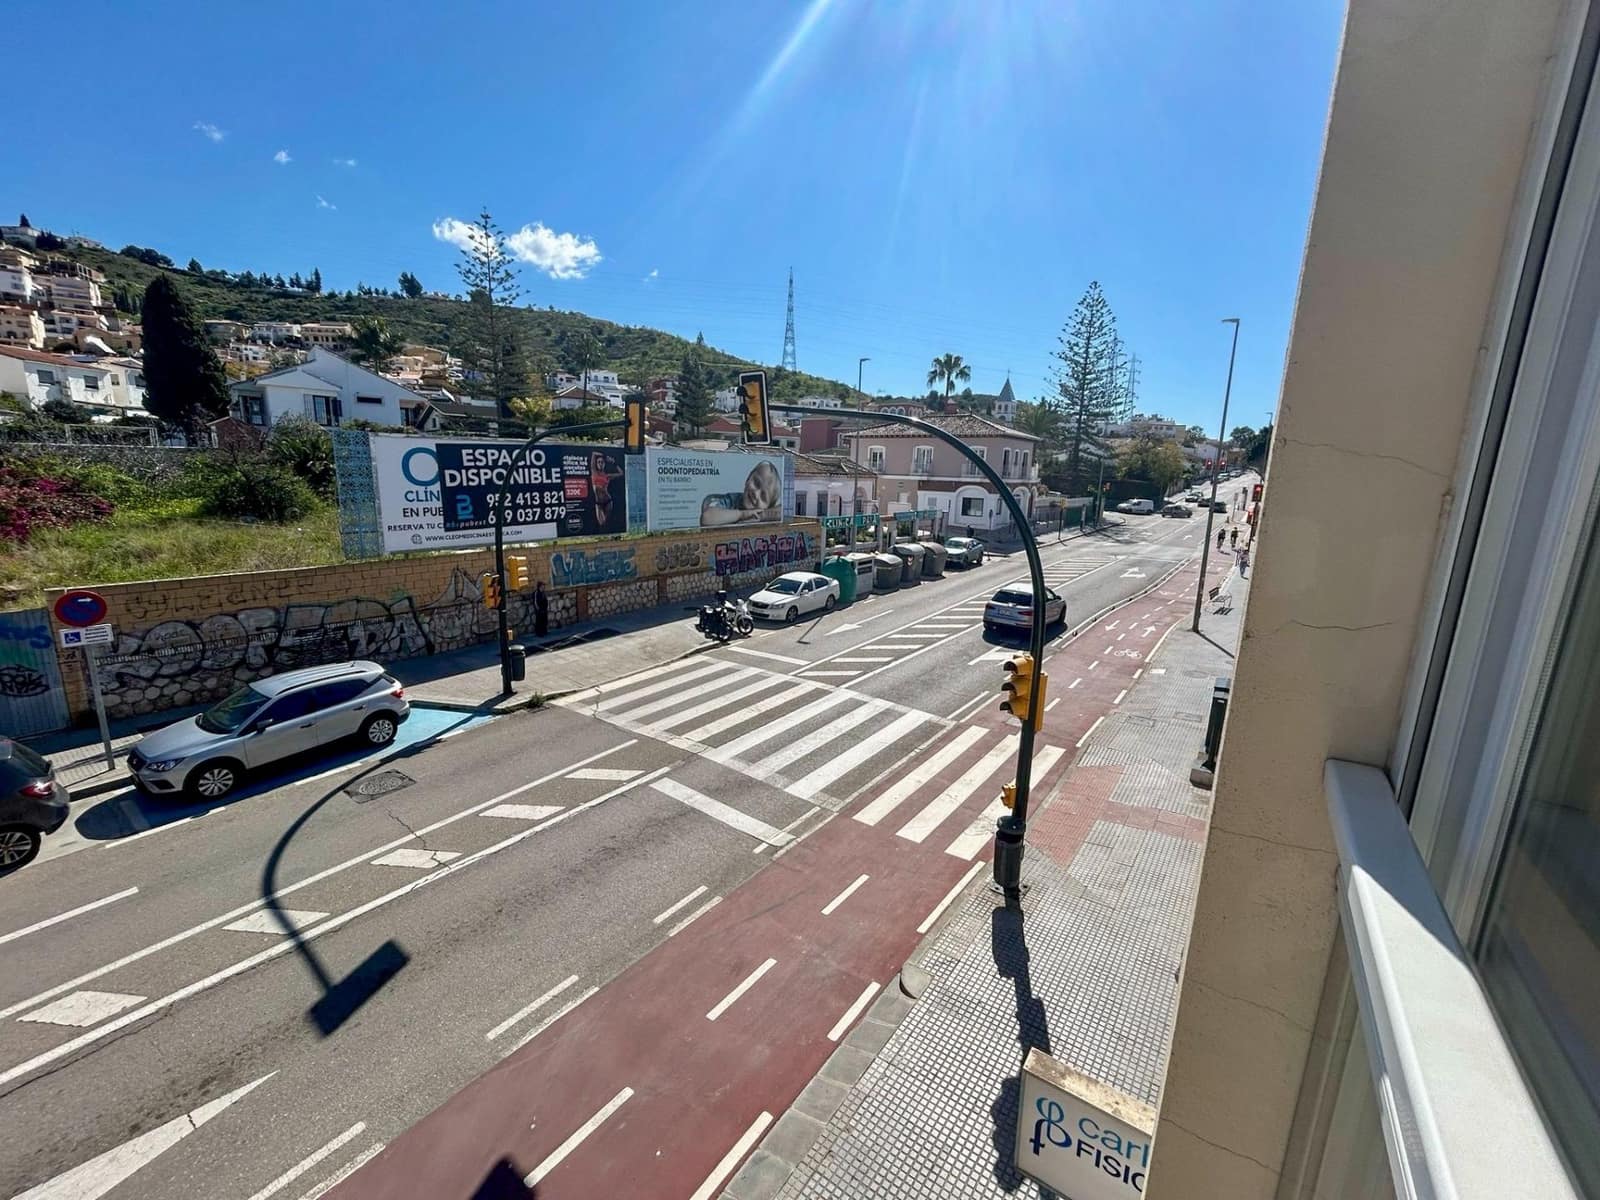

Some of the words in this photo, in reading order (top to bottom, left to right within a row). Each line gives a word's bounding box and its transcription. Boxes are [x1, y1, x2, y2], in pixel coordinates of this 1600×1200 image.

[657, 457, 704, 466] ESPECIALISTAS
[705, 459, 713, 467] EN
[658, 466, 720, 476] ODONTOPEDIATRÍA
[444, 467, 562, 487] DISPONIBLE
[516, 491, 540, 505] 413
[543, 490, 565, 503] 821
[402, 507, 419, 517] EN
[488, 508, 513, 524] 69
[517, 507, 540, 522] 037
[544, 506, 566, 520] 879
[387, 523, 424, 532] RESERVA
